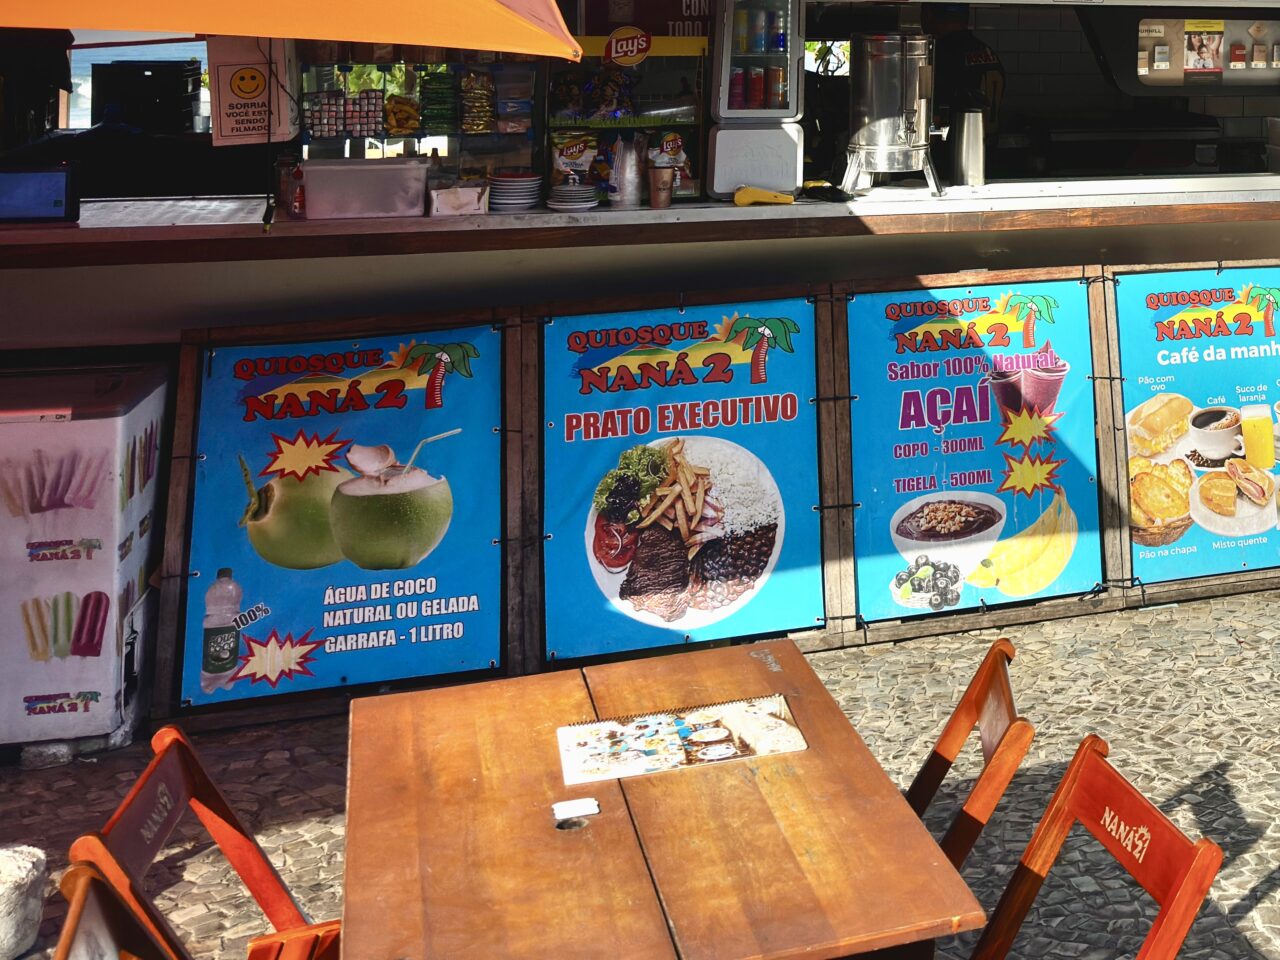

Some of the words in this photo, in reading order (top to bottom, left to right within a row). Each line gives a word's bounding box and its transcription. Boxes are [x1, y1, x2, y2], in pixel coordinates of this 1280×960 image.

[611, 34, 647, 57] Lay's
[235, 117, 265, 125] SENDO
[885, 296, 992, 322] QUIOSQUE
[1145, 287, 1236, 311] QUIOSQUE
[567, 320, 709, 353] QUIOSQUE
[895, 323, 984, 355] NANÁ
[986, 322, 1011, 348] 2
[1155, 311, 1232, 342] NANÁ
[1232, 312, 1254, 337] 2
[233, 348, 384, 381] QUIOSQUE
[887, 360, 940, 382] Sabor
[943, 355, 991, 378] 100%
[992, 349, 1056, 373] Natural
[1157, 345, 1200, 366] Café
[1203, 344, 1227, 362] da
[579, 354, 700, 395] NANÁ
[702, 352, 732, 386] 2
[1138, 375, 1155, 385] Pão
[1155, 375, 1175, 383] com
[244, 380, 370, 422] NANÁ
[374, 379, 407, 410] 2
[1206, 395, 1226, 405] Café
[1235, 385, 1256, 394] Suco
[1257, 383, 1268, 393] de
[1238, 392, 1267, 403] laranja
[564, 406, 651, 442] PRATO
[657, 392, 799, 437] EXECUTIVO
[899, 380, 991, 434] AÇAÍ
[893, 442, 930, 460] COPO
[942, 436, 985, 457] 300ML
[894, 474, 938, 494] TIGELA
[950, 469, 994, 488] 500ML
[1139, 548, 1156, 559] Pão
[1157, 549, 1168, 557] na
[1169, 544, 1197, 558] chapa
[1212, 539, 1238, 550] Misto
[1239, 535, 1268, 549] quente
[324, 586, 367, 605] ÁGUA
[370, 582, 390, 600] DE
[393, 577, 437, 597] COCO
[231, 602, 271, 631] 100%
[323, 604, 392, 628] NATURAL
[396, 601, 418, 619] OU
[421, 595, 479, 617] GELADA
[324, 629, 397, 653] GARRAFA
[408, 627, 417, 643] 1
[420, 622, 464, 642] LITRO
